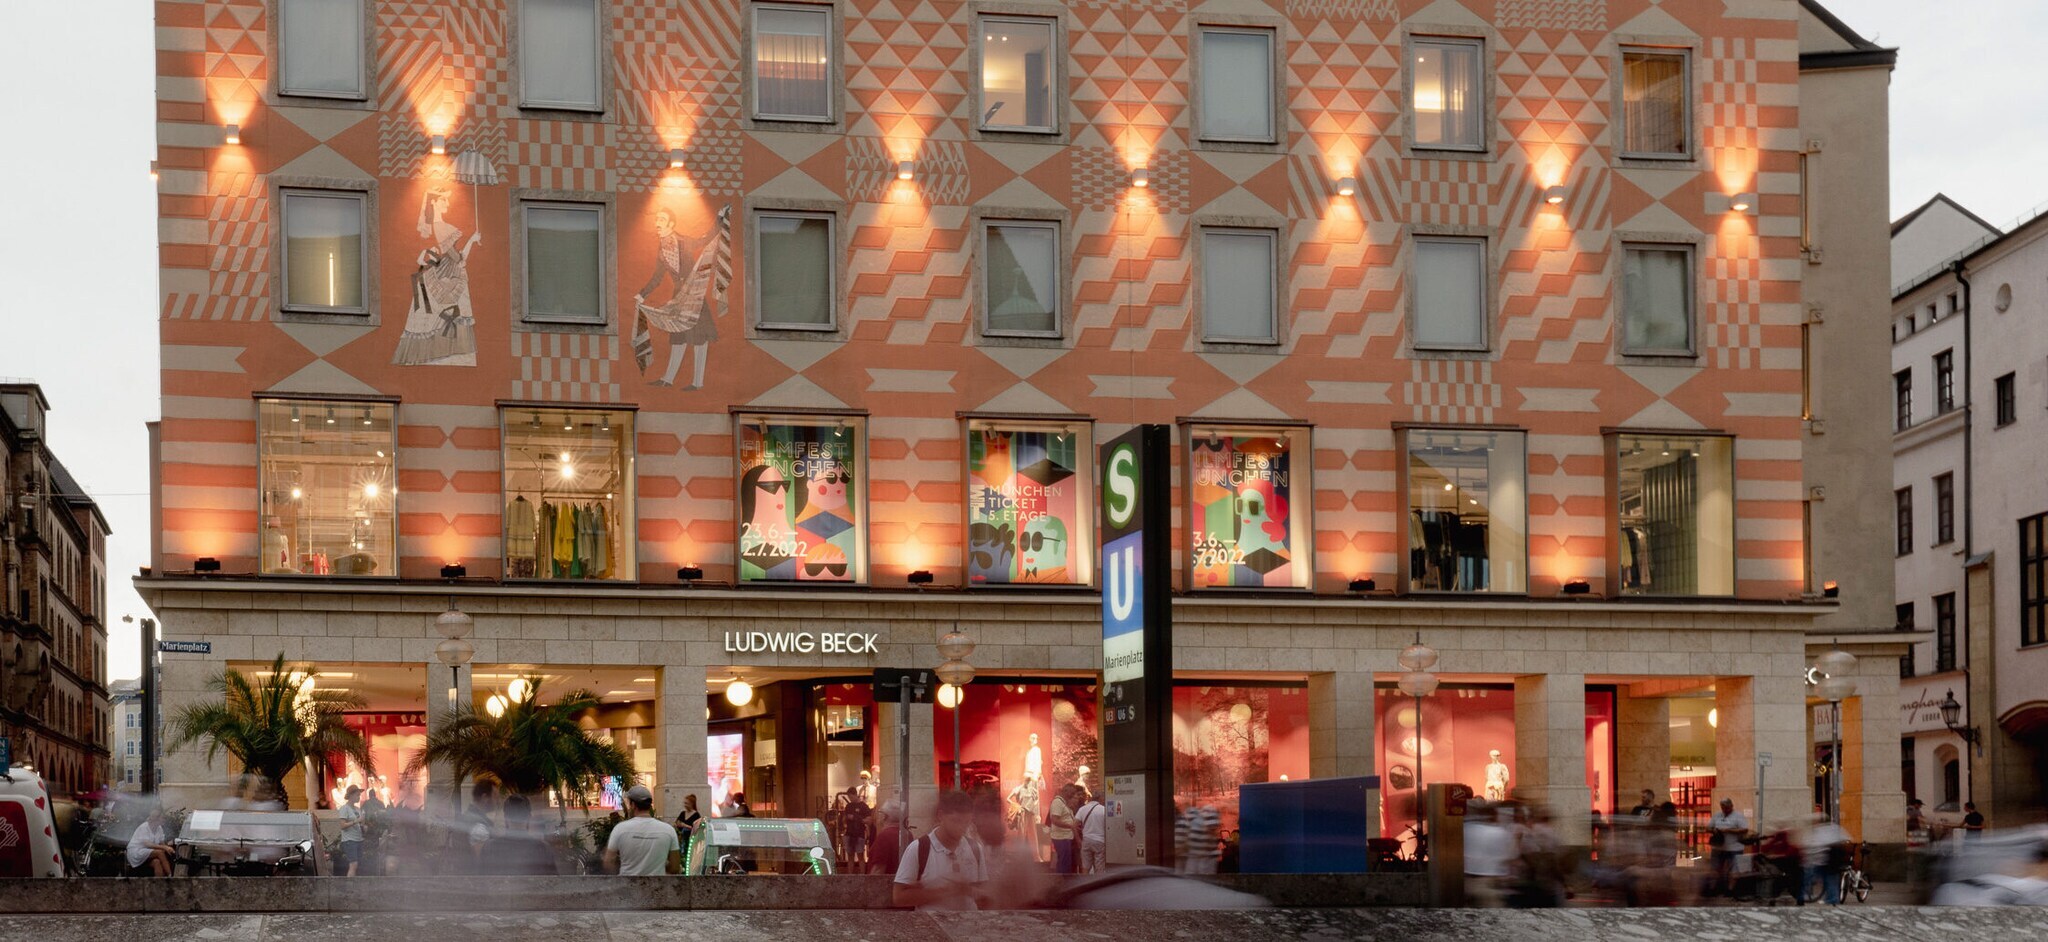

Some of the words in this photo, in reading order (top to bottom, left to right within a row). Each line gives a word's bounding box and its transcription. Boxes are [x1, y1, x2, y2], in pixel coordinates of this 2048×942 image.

[742, 440, 848, 460] FILMFEST
[1109, 449, 1135, 523] S
[988, 497, 1038, 509] TICKET
[988, 510, 999, 521] 5.
[1003, 510, 1048, 522] ETAGE
[1110, 546, 1134, 621] U
[161, 641, 208, 652] Marienplatz
[725, 631, 815, 653] LUDWIG
[821, 632, 879, 654] BECK
[1104, 650, 1143, 670] Marienplatz
